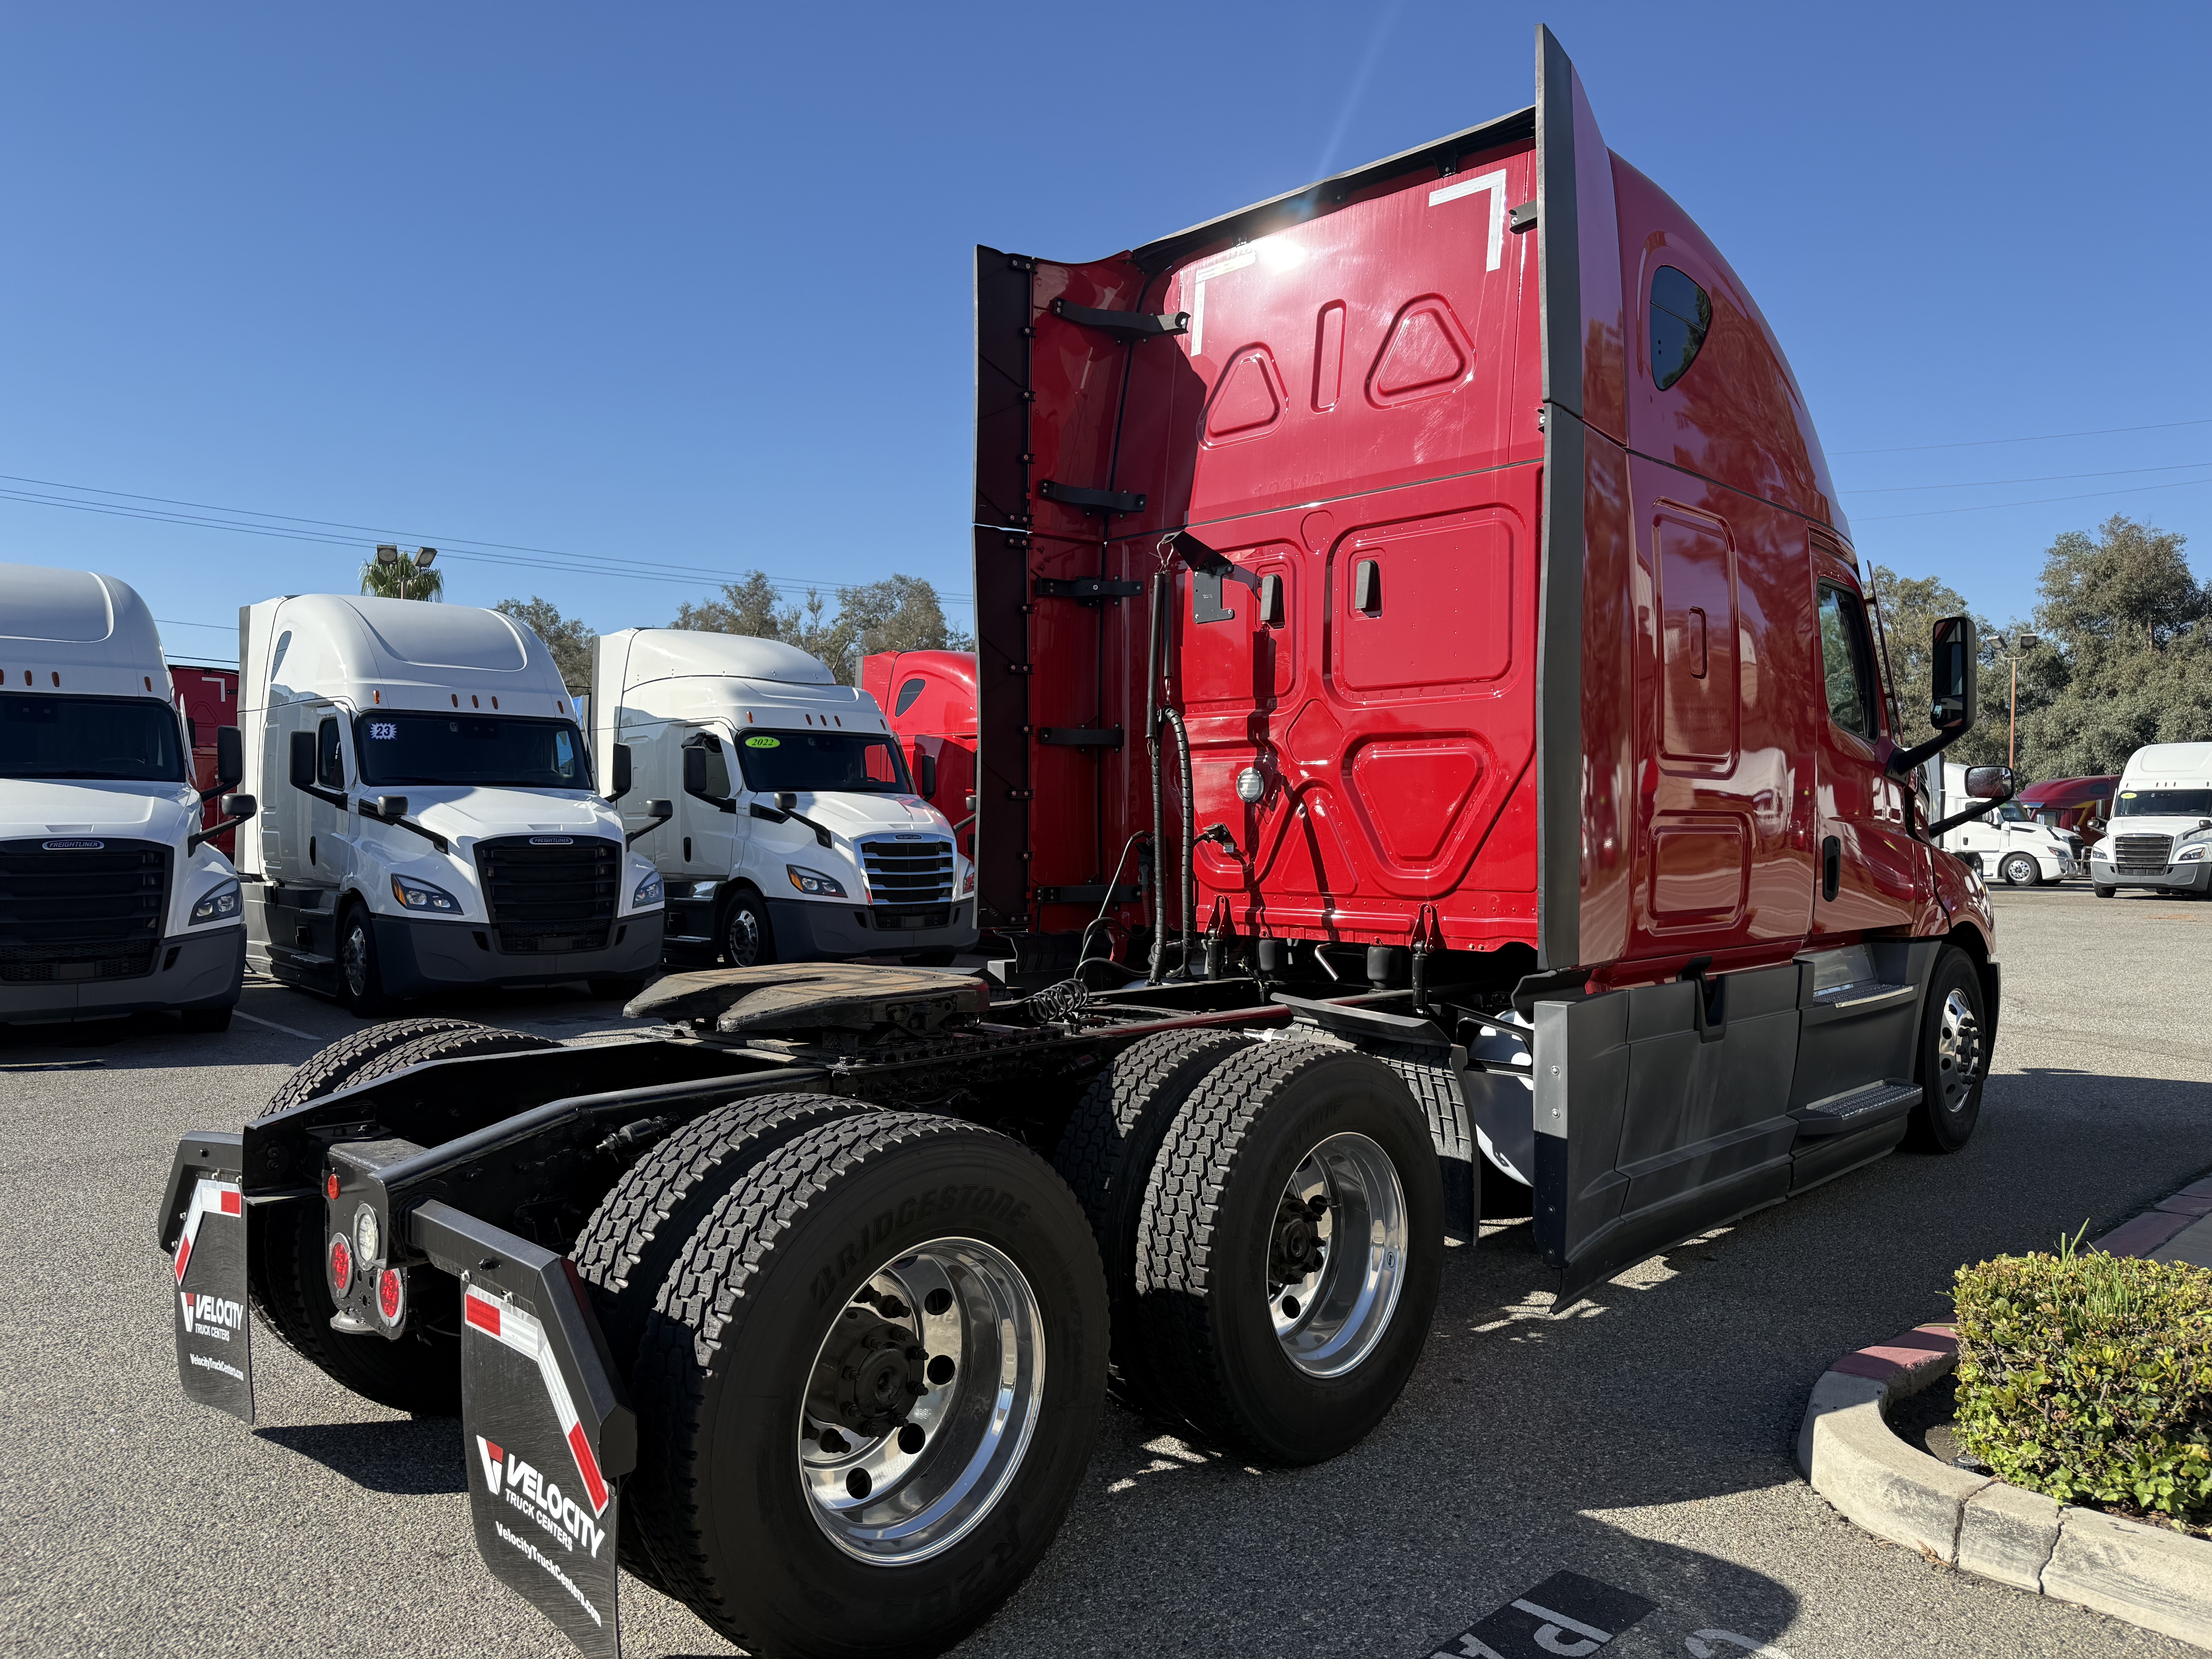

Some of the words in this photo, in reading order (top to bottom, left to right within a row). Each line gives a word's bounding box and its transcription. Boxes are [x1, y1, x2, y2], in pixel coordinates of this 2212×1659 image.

[376, 726, 390, 736] 23
[809, 1184, 1032, 1310] BRIDGESTONE
[195, 1323, 211, 1336] TRUCK
[211, 1326, 230, 1342] CENTERS
[196, 1294, 244, 1330] VELOCITY
[190, 1353, 244, 1381] VelocityTruckCenters.com
[505, 1488, 534, 1519] TRUCK
[536, 1510, 573, 1552] CENTERS
[507, 1453, 605, 1558] VELOCITY
[495, 1521, 601, 1628] VelocityTruckCenters.com
